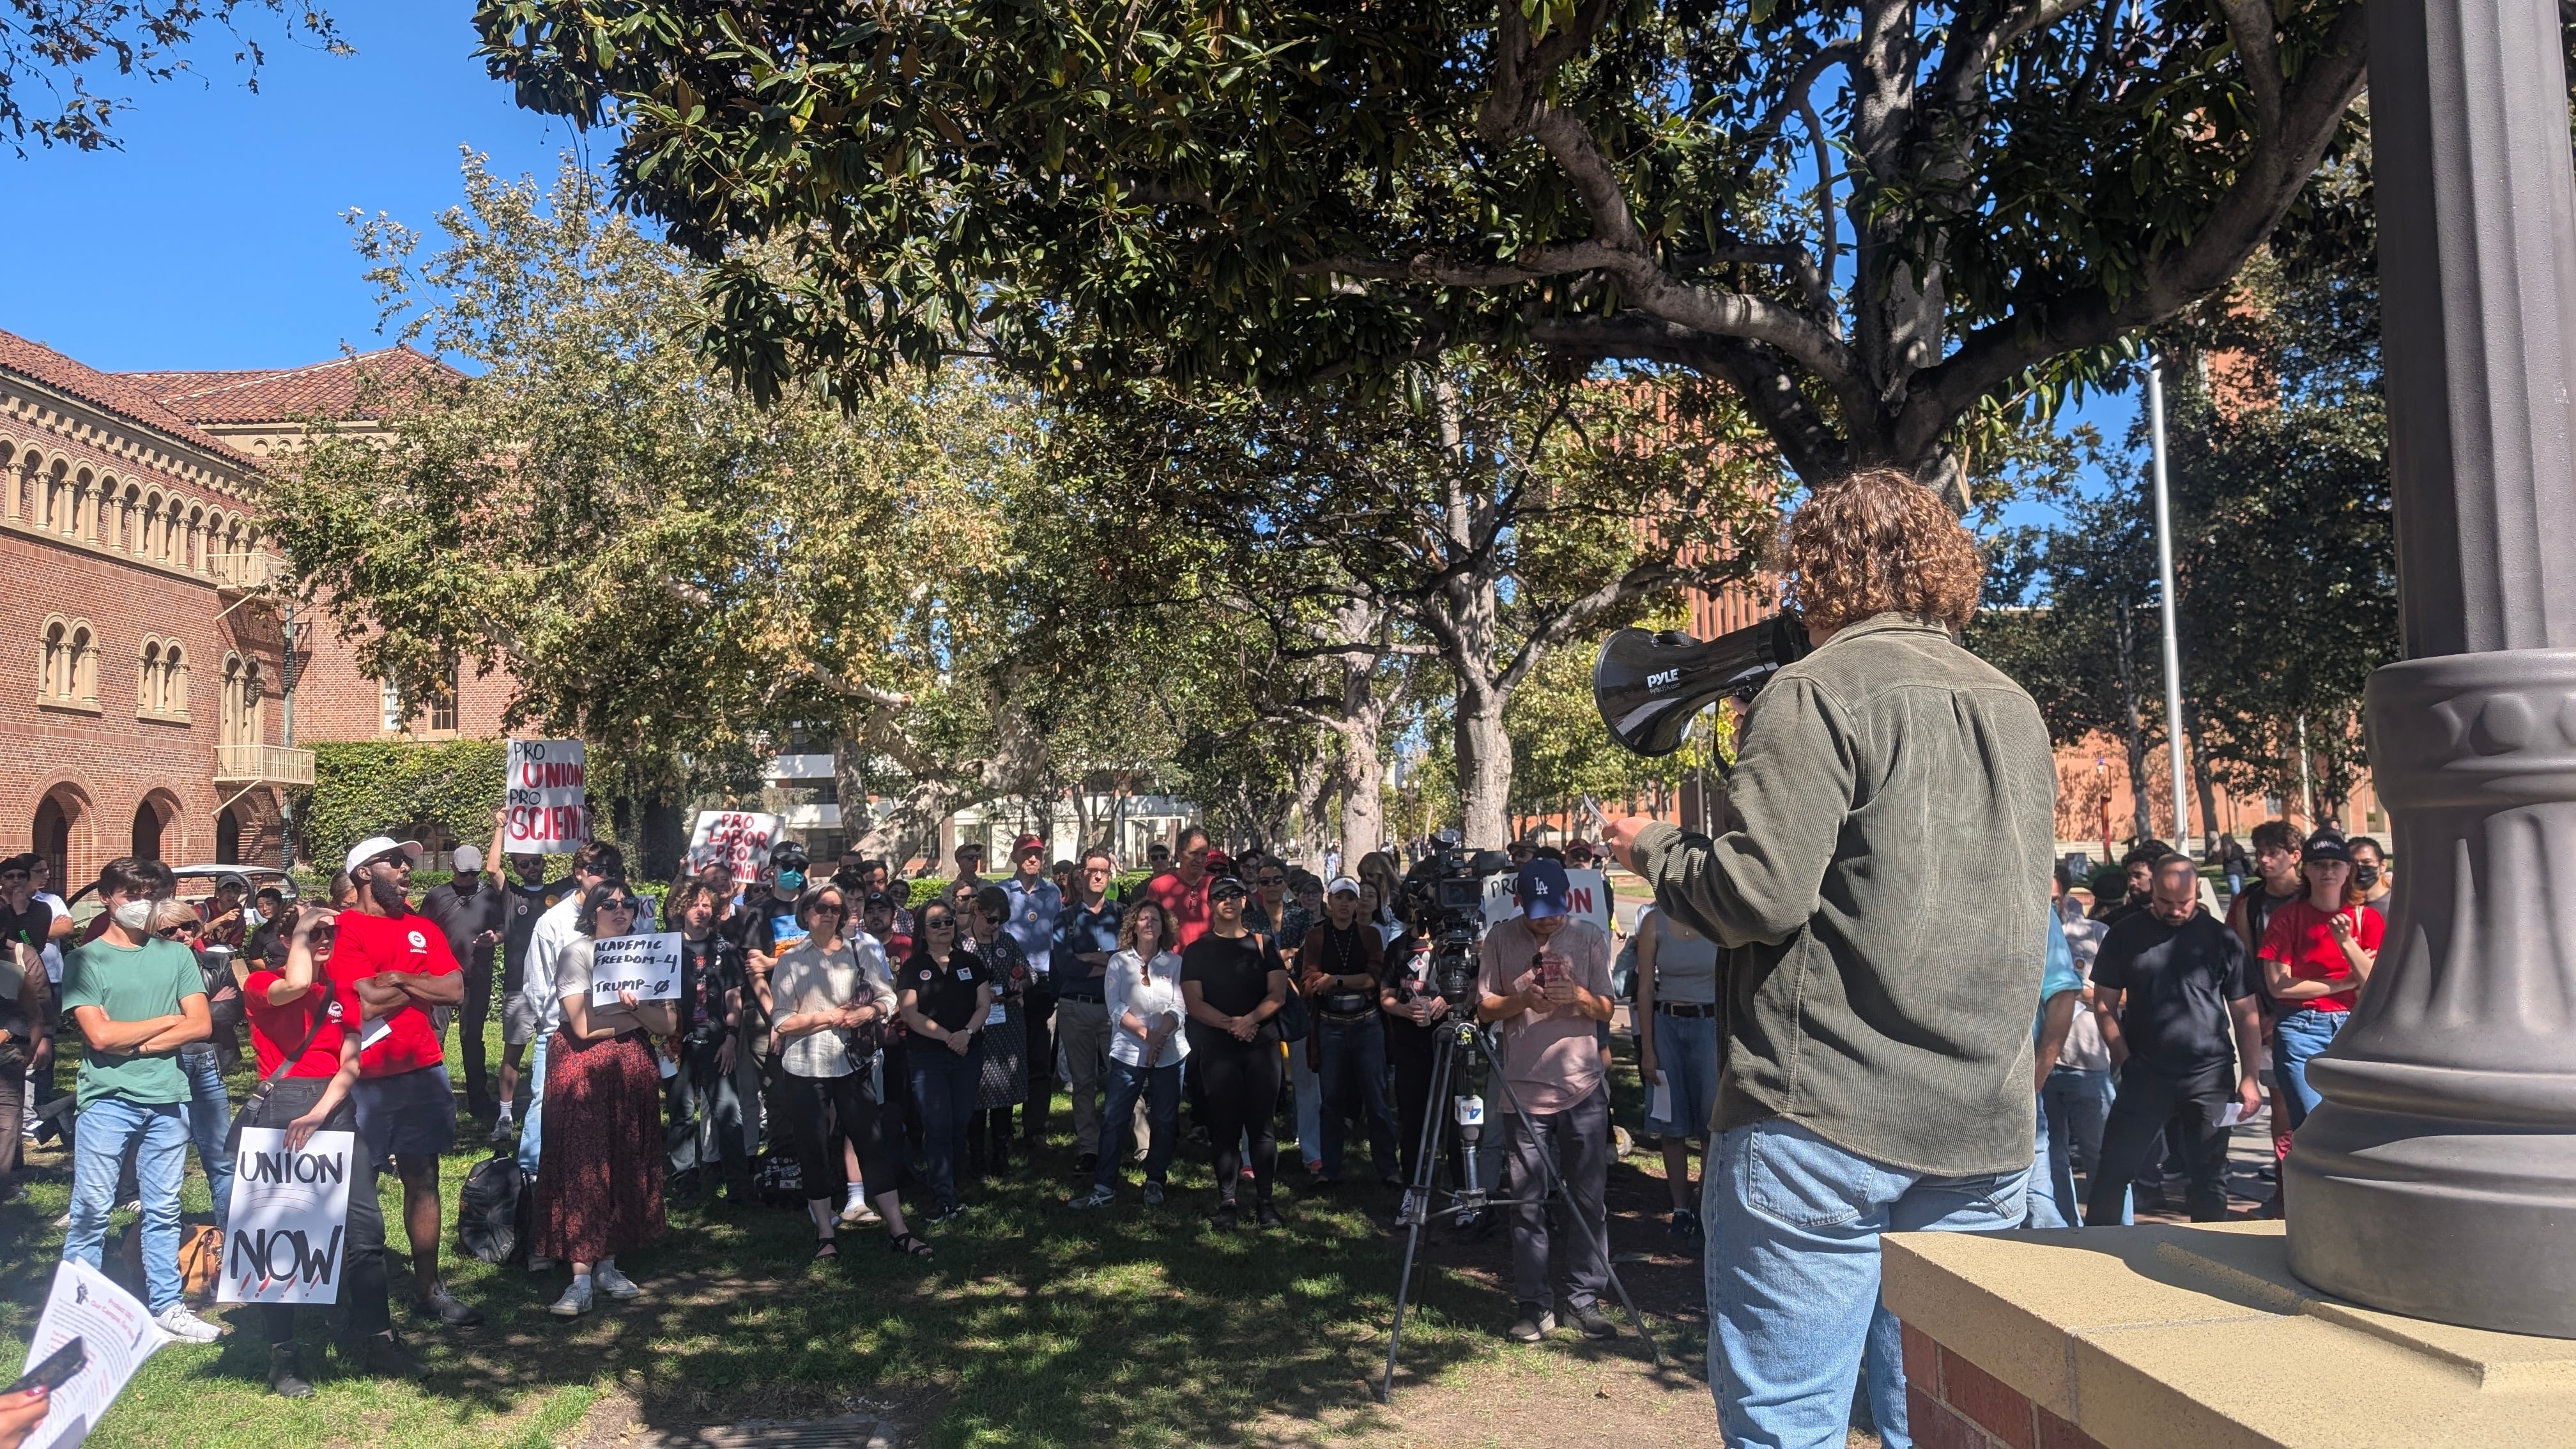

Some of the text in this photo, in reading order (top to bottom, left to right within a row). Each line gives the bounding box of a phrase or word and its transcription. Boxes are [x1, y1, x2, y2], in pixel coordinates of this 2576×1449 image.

[514, 742, 546, 762] PRO
[523, 762, 584, 788] UNION
[509, 789, 541, 805] PRO
[721, 814, 755, 829] PRO
[709, 829, 769, 851] LABOR
[715, 845, 748, 861] PRO
[1535, 877, 1548, 894] LA
[594, 940, 663, 953] ACADEMIC
[240, 1151, 343, 1184] UNION
[230, 1225, 344, 1285] NOW
